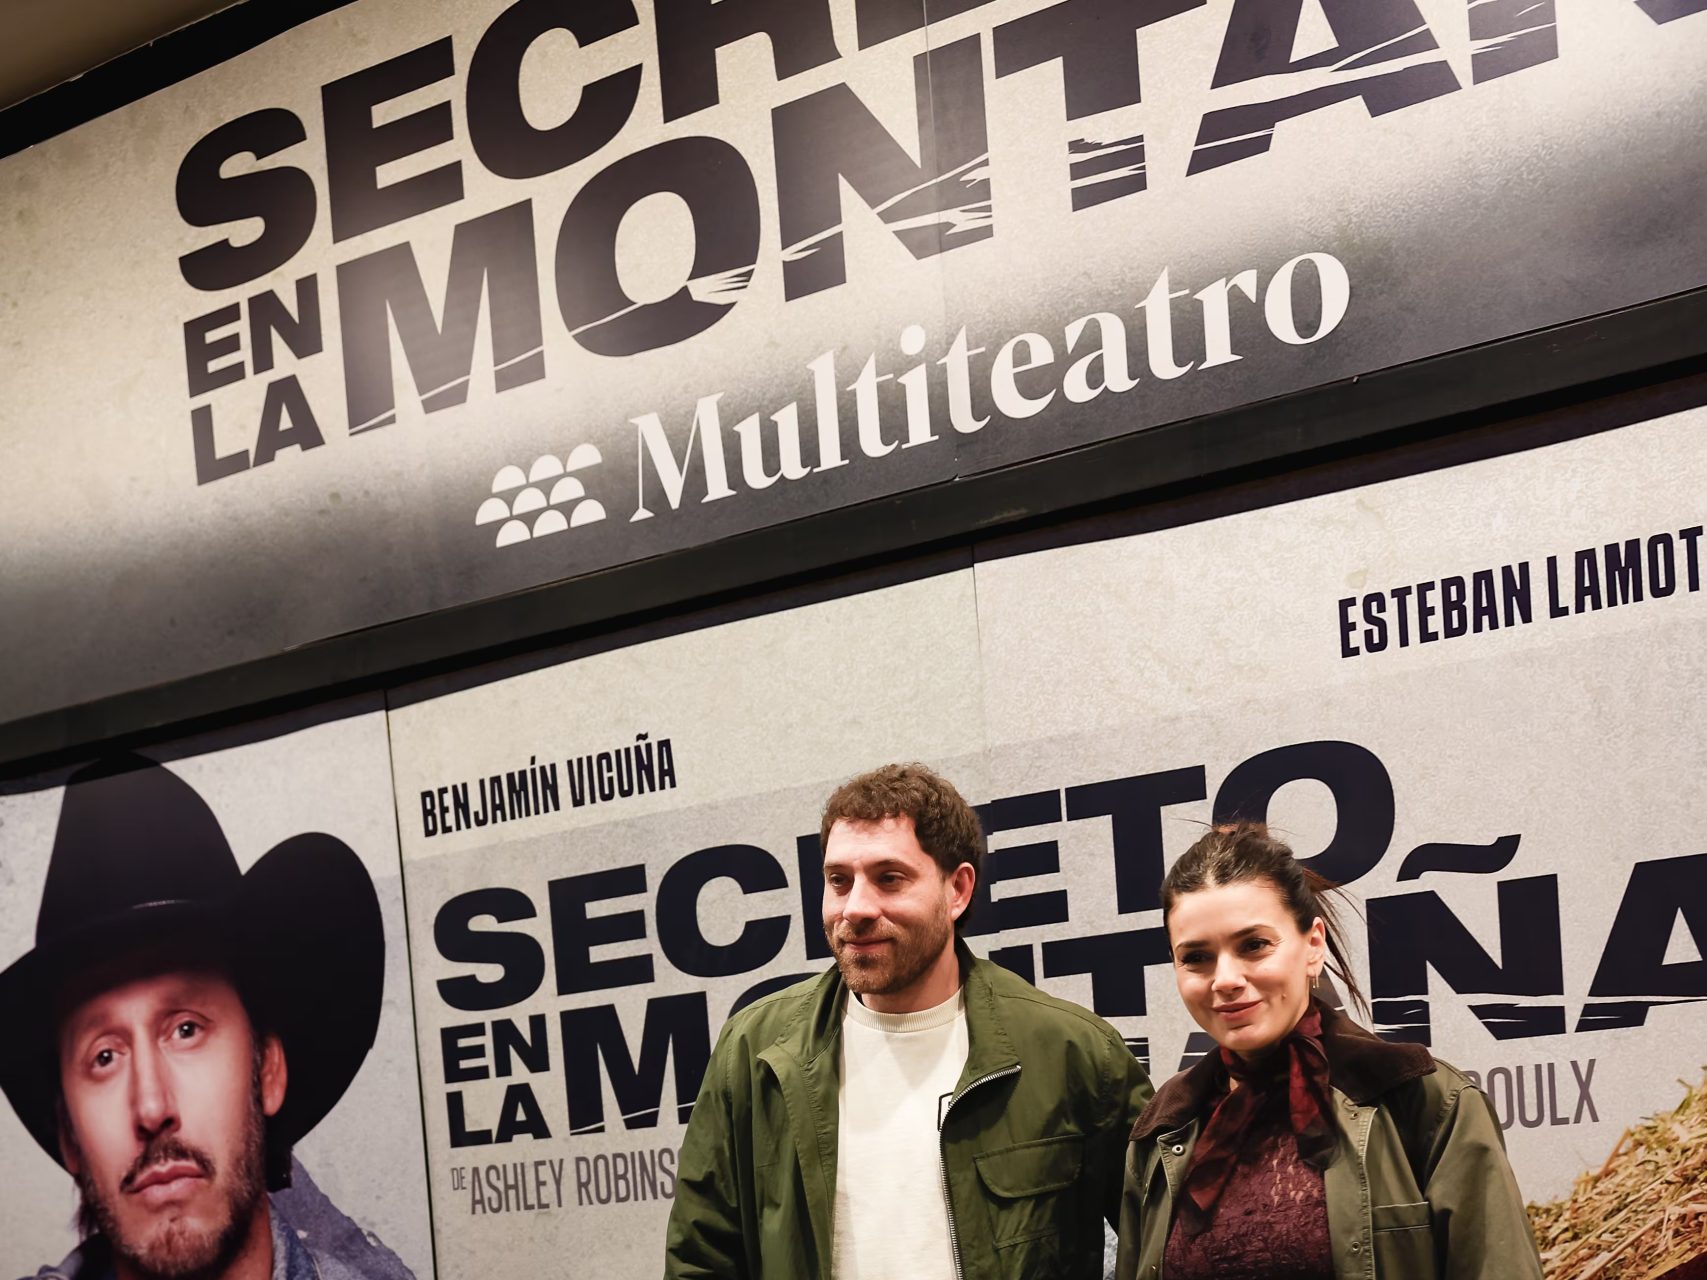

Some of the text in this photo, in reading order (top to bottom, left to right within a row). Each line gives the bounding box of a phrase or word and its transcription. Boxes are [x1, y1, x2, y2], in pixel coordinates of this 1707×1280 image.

[183, 272, 324, 398] EN
[628, 251, 1351, 522] Multiteatro
[190, 373, 326, 486] LA
[1338, 525, 1704, 659] ESTEBAN LAMOT
[421, 732, 677, 837] BENJAMÍN VICUÑA
[433, 739, 1396, 1013] SECETO
[440, 1013, 551, 1084] EN
[1461, 1058, 1600, 1131] OULX
[445, 1082, 552, 1149] LA
[451, 1147, 682, 1215] DE ASHLEY ROBINS
